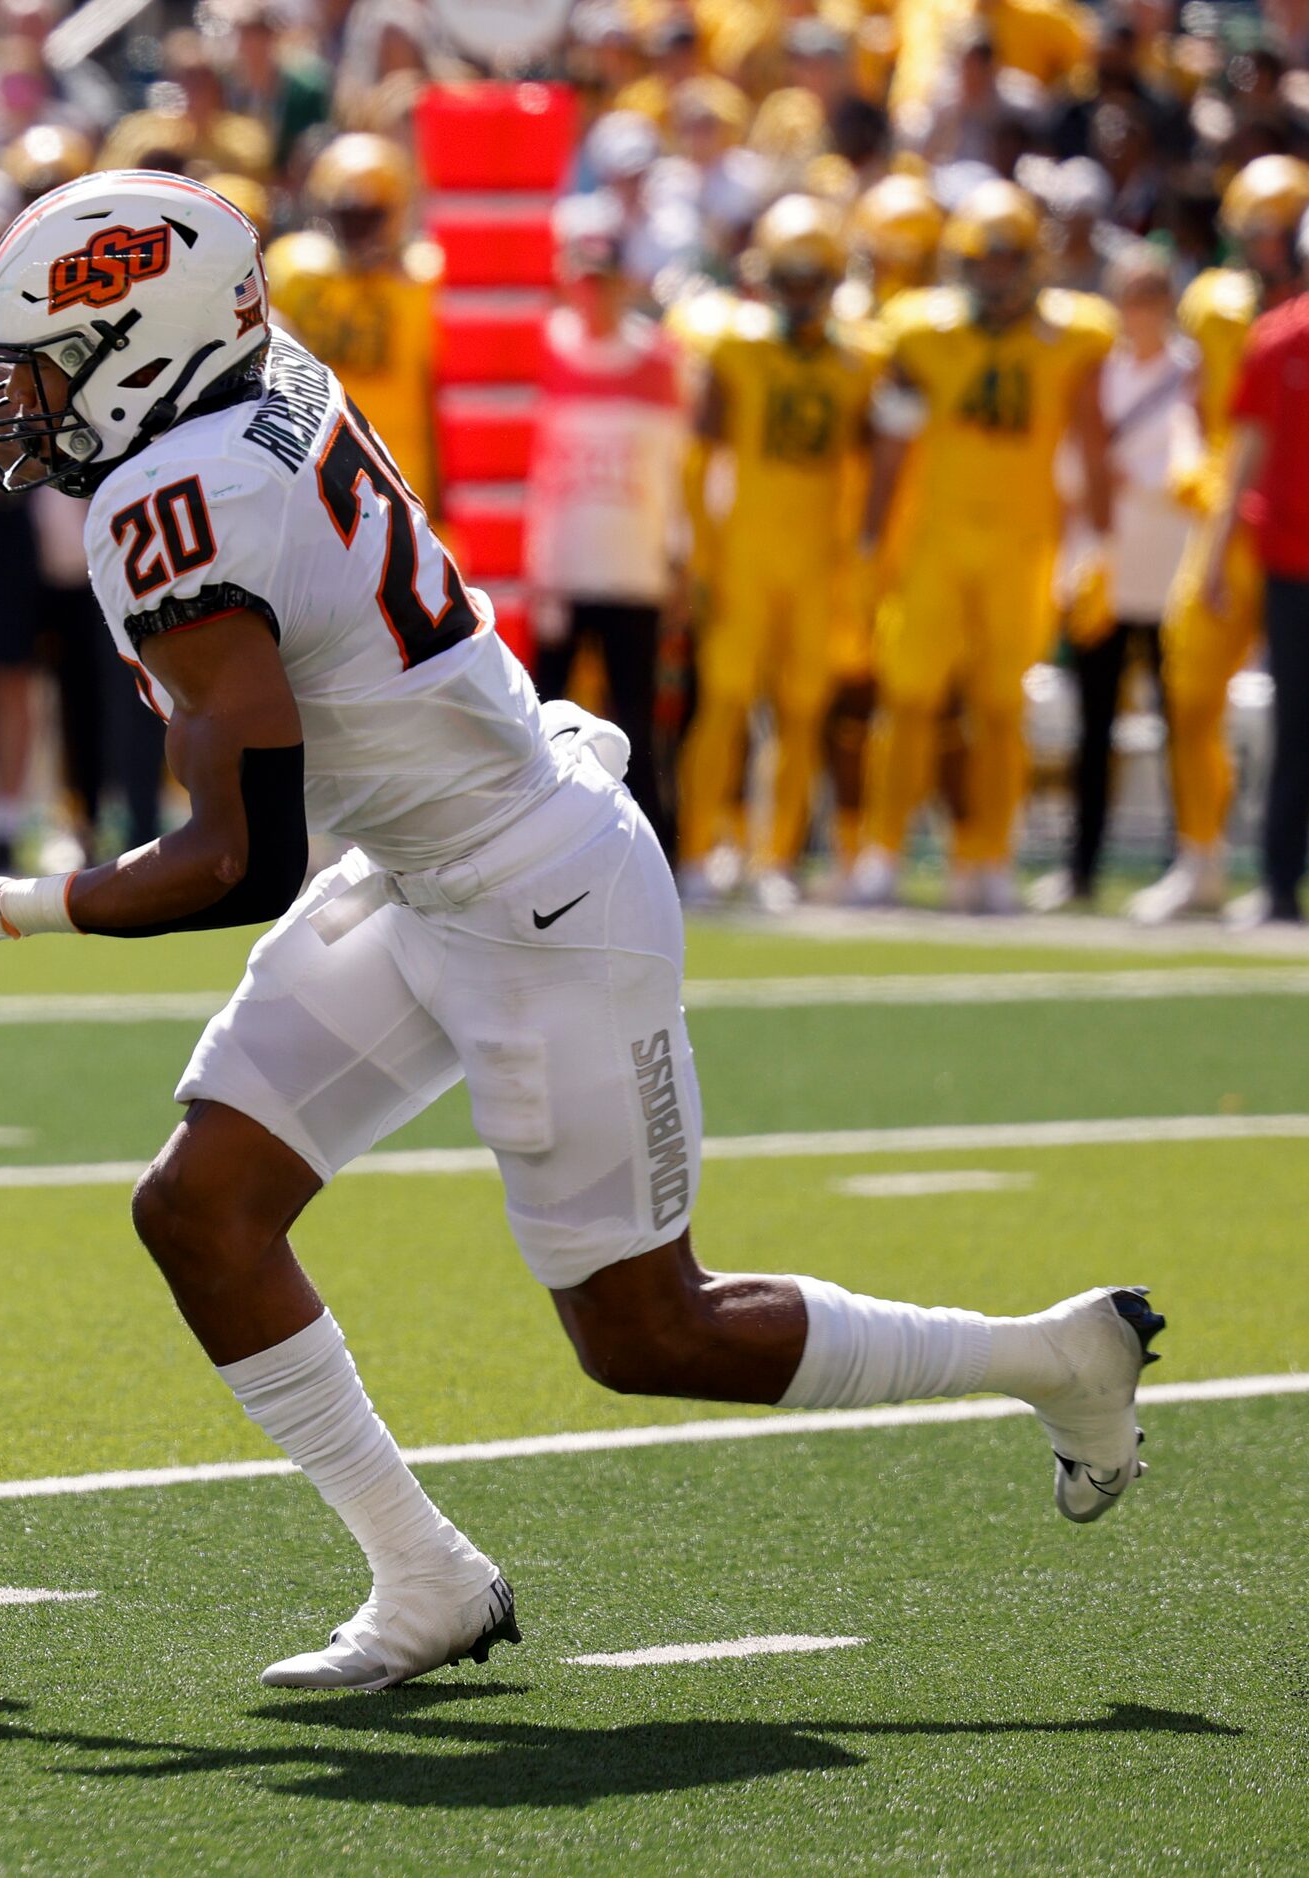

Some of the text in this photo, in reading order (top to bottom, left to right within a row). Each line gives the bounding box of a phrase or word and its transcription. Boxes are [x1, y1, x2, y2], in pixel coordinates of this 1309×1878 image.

[48, 224, 172, 315] OSU
[109, 473, 218, 600] 20
[315, 393, 487, 674] 2
[631, 1028, 690, 1232] COWBOYS
